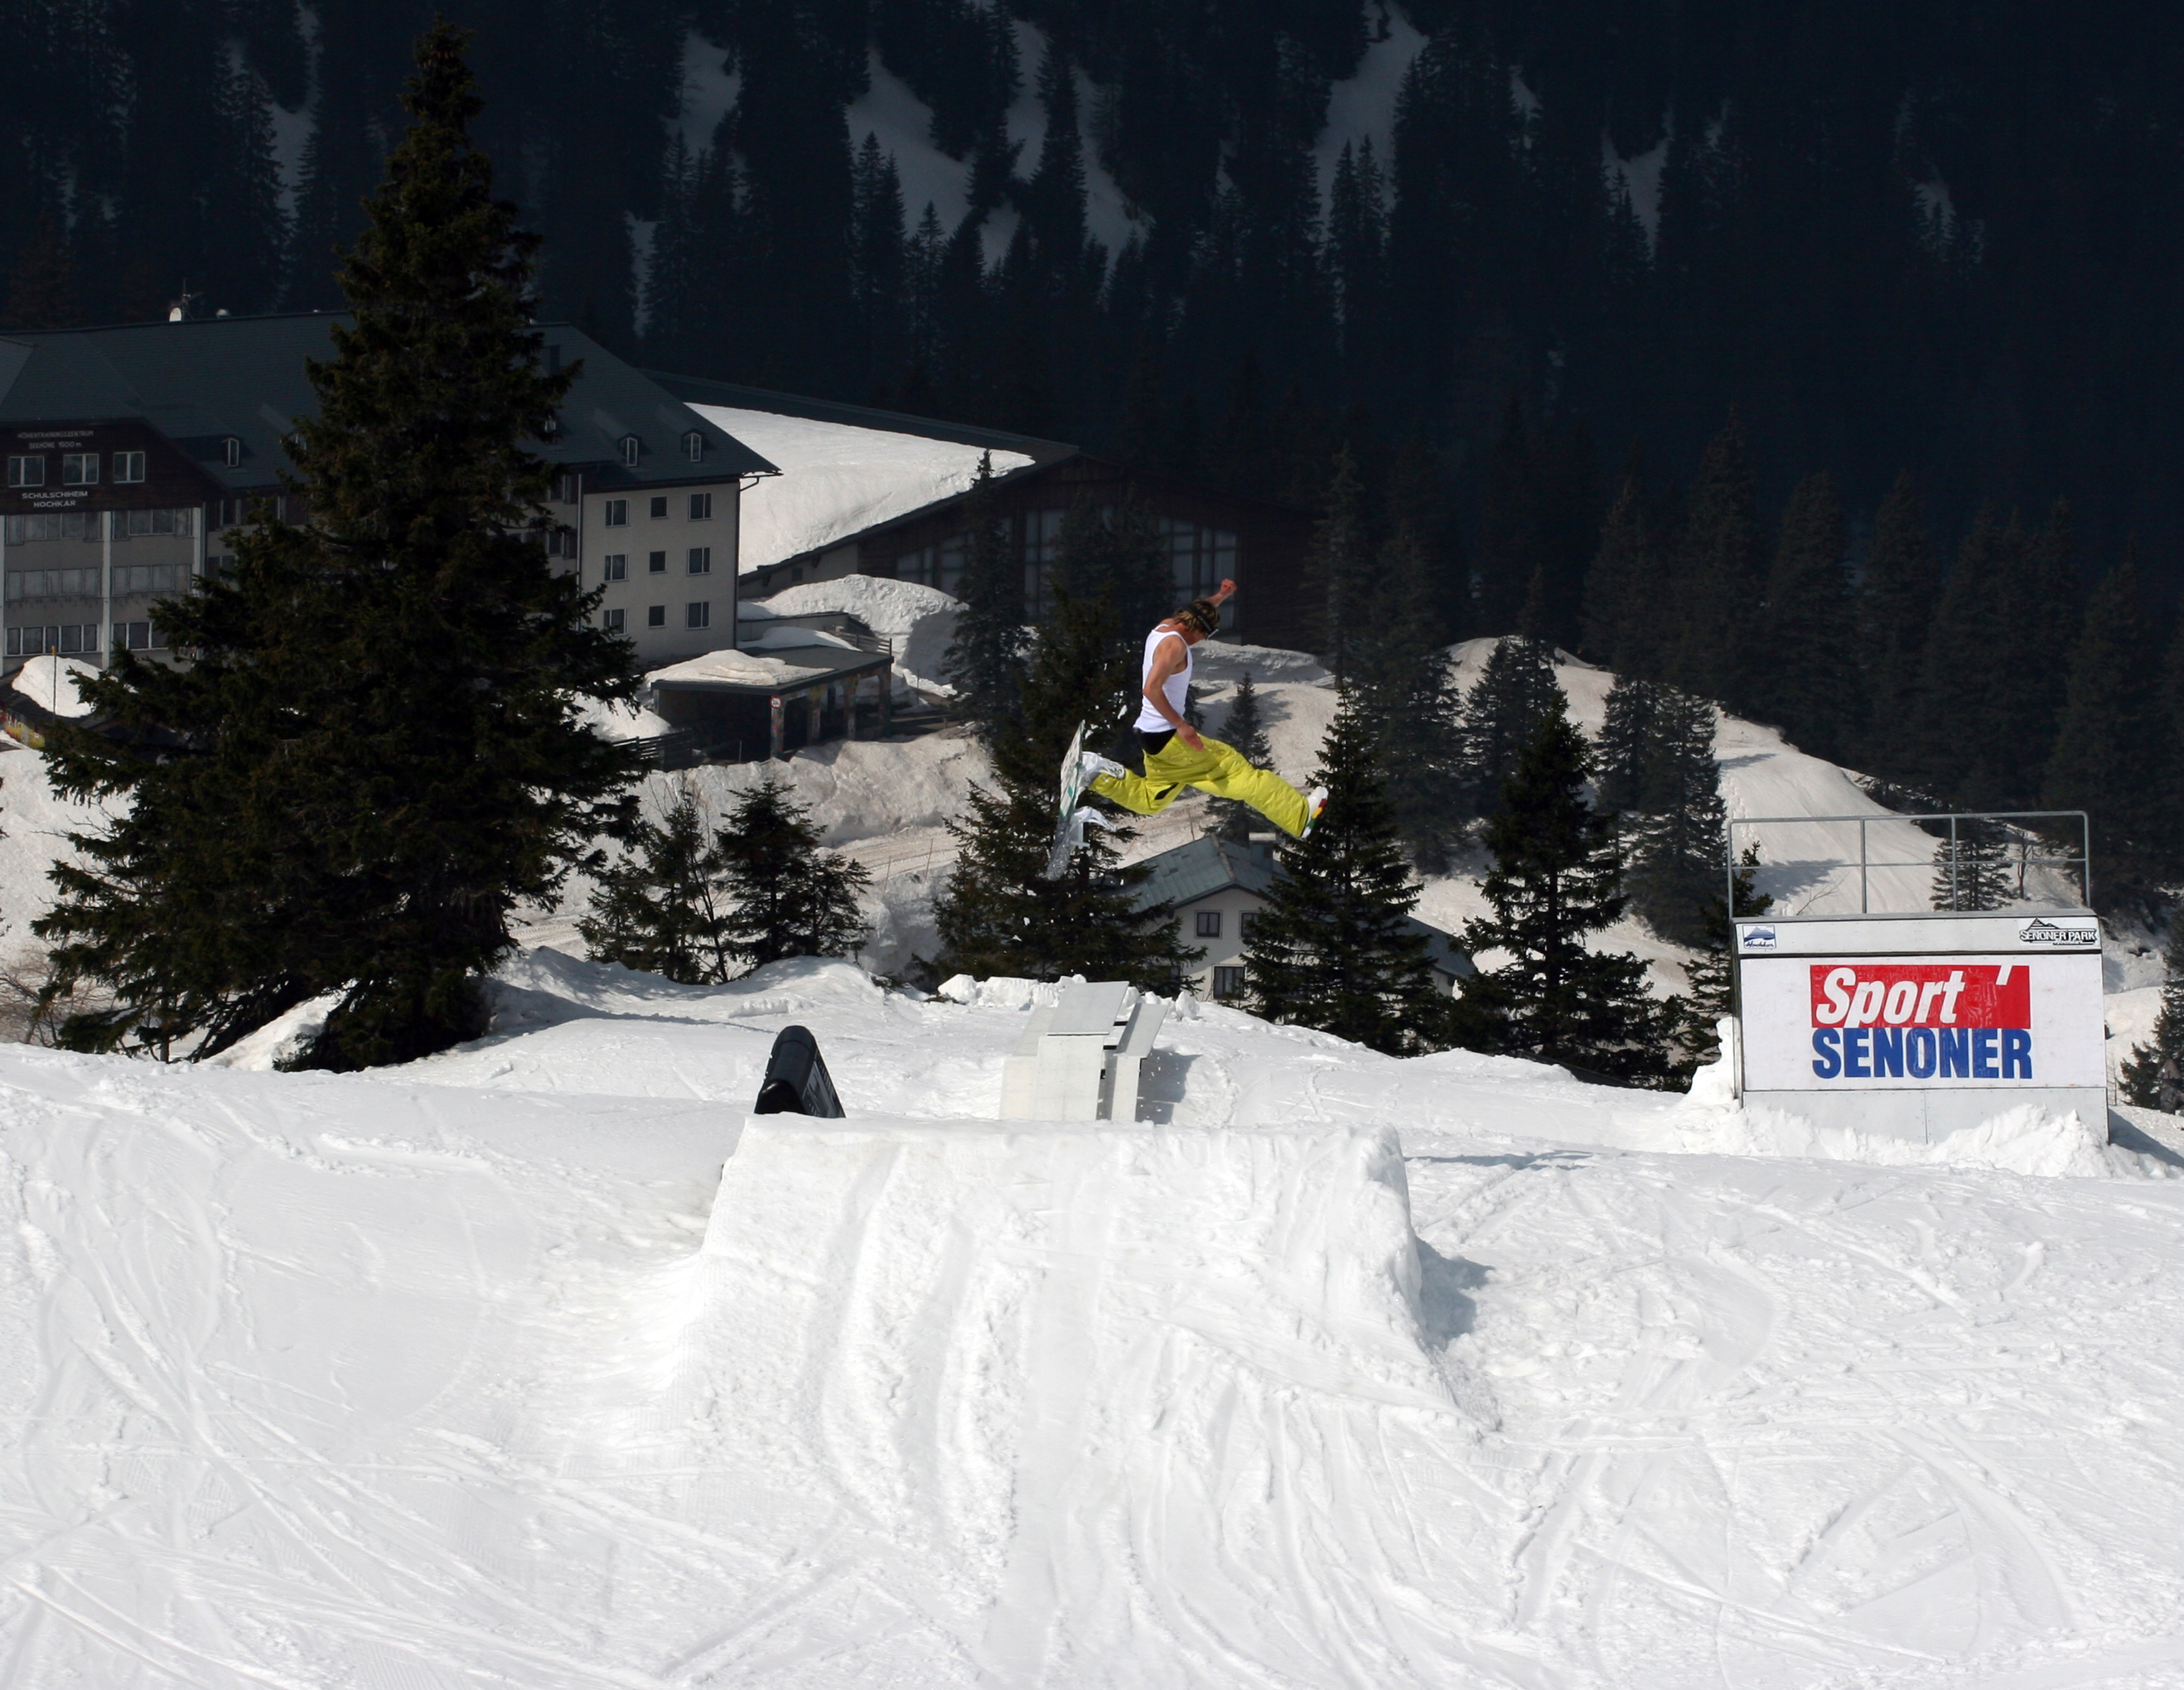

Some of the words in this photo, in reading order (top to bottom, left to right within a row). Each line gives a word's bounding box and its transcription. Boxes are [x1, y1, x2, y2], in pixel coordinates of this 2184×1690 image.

[22, 490, 88, 499] SCHULSCHIHEIM
[2020, 930, 2066, 941] SENONER
[2068, 931, 2095, 941] PARK
[1816, 967, 1966, 1027] Sport
[1812, 1027, 2032, 1079] SENONER
